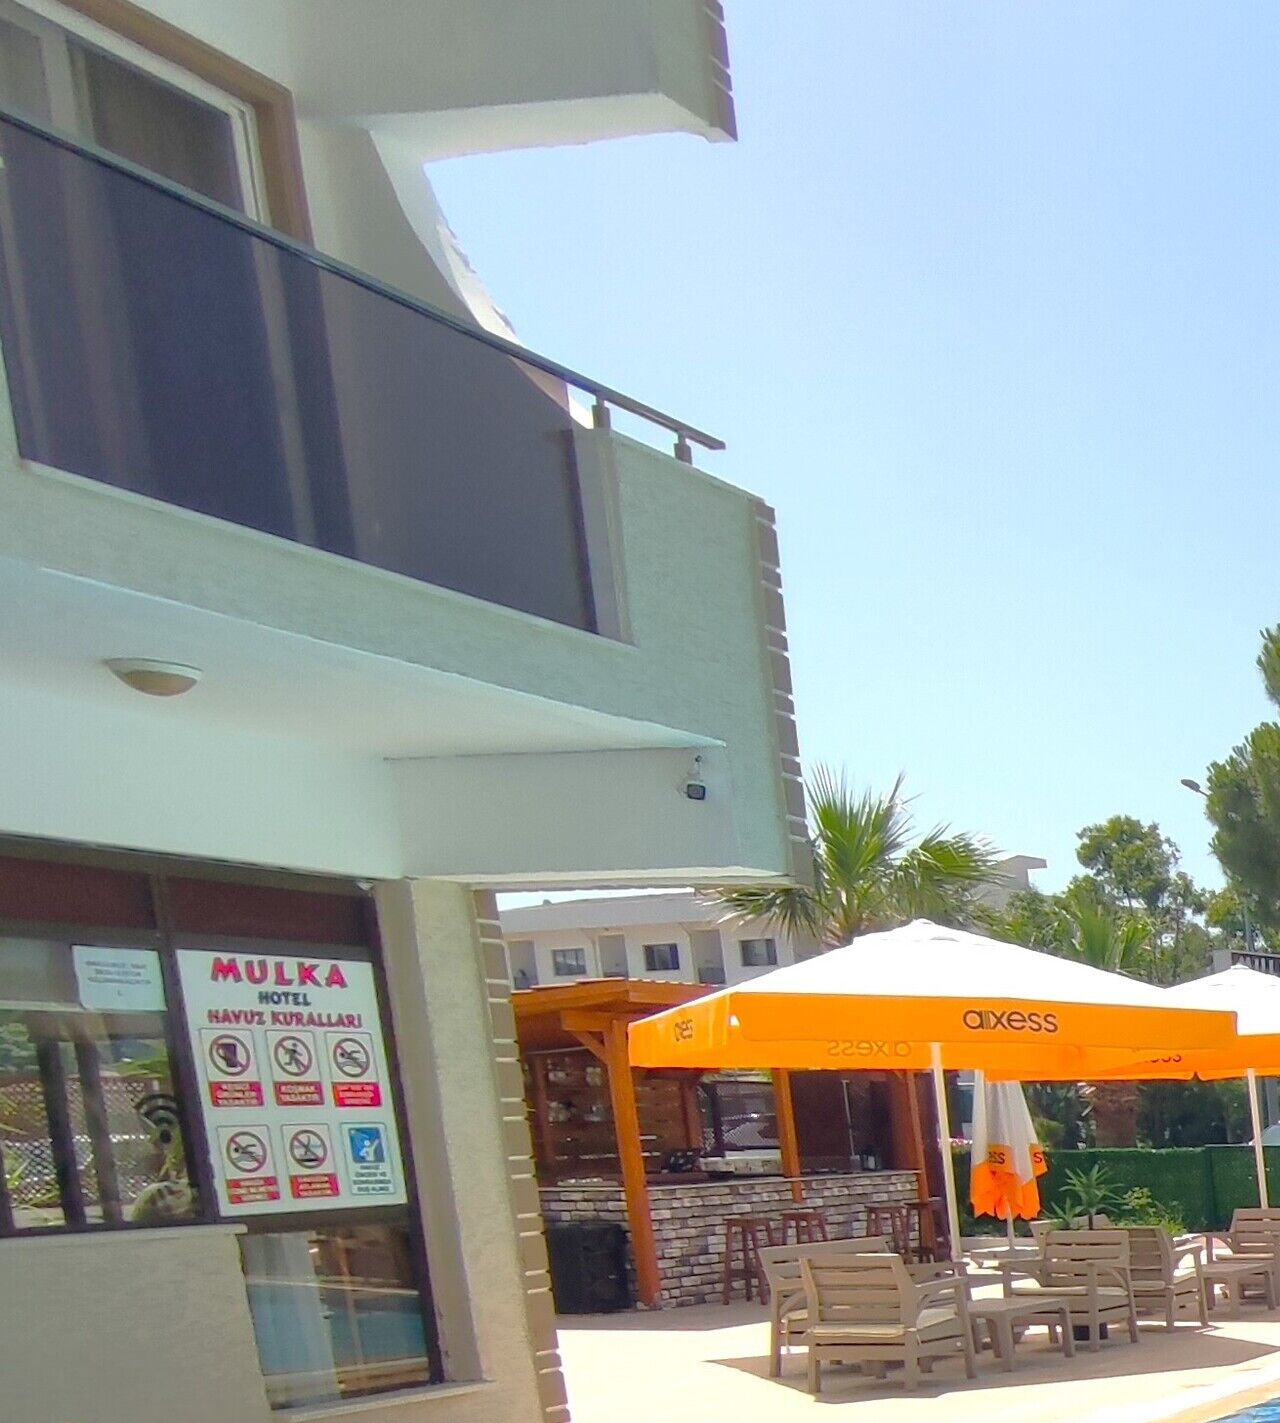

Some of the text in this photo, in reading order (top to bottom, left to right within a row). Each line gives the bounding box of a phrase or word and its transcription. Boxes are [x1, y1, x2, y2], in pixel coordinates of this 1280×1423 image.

[210, 956, 348, 988] MULKA
[258, 991, 312, 1006] HOTEL
[207, 1009, 362, 1028] HAVUZ KURALLARI
[963, 1010, 1058, 1033] axess
